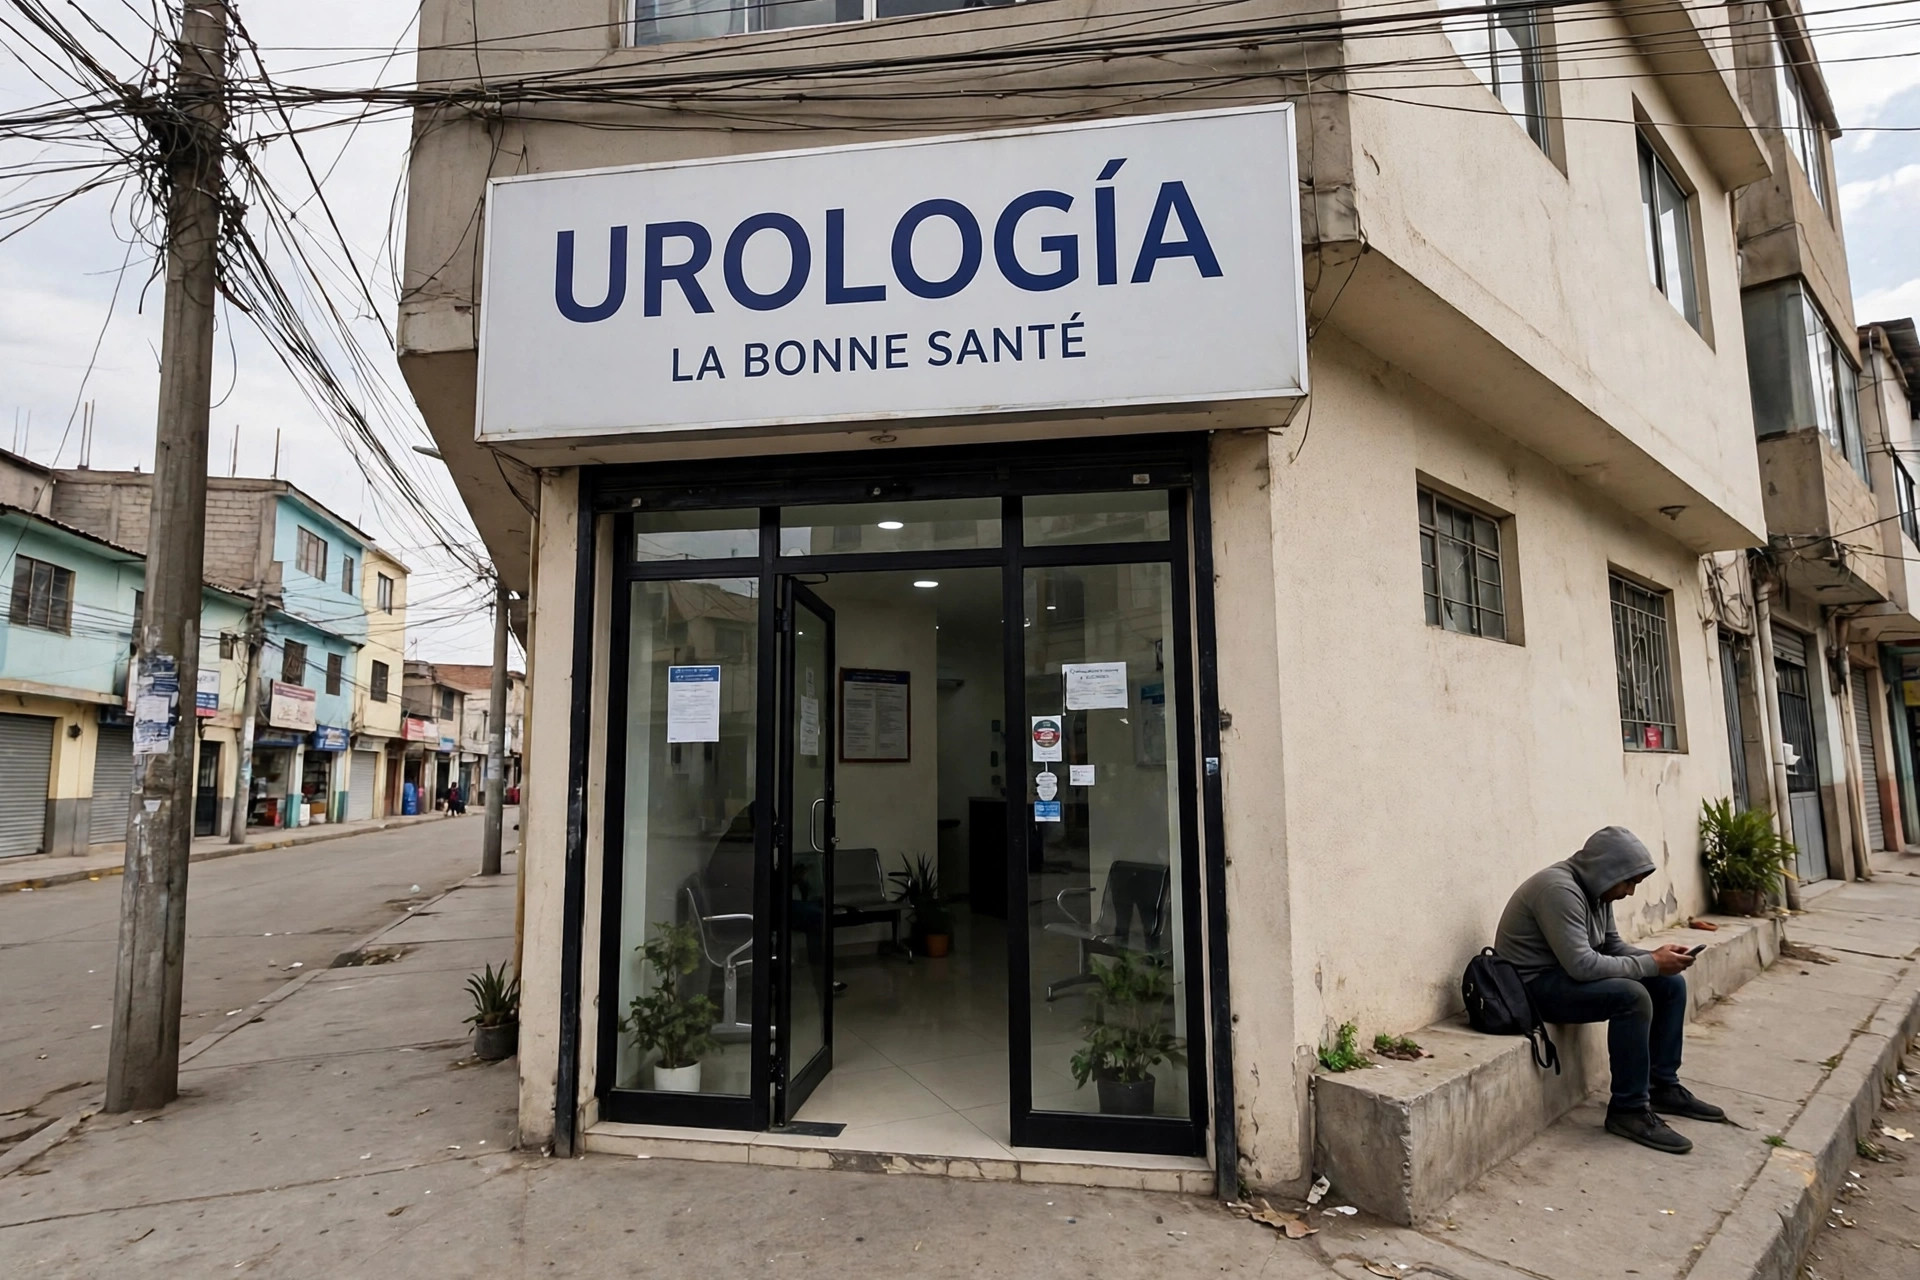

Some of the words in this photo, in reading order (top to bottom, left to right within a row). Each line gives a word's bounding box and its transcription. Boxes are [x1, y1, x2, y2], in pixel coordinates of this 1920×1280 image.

[554, 157, 1224, 324] UROLOGÍA
[672, 345, 726, 382] LA
[744, 332, 909, 378] BONNE
[927, 311, 1087, 367] SANTÉ
